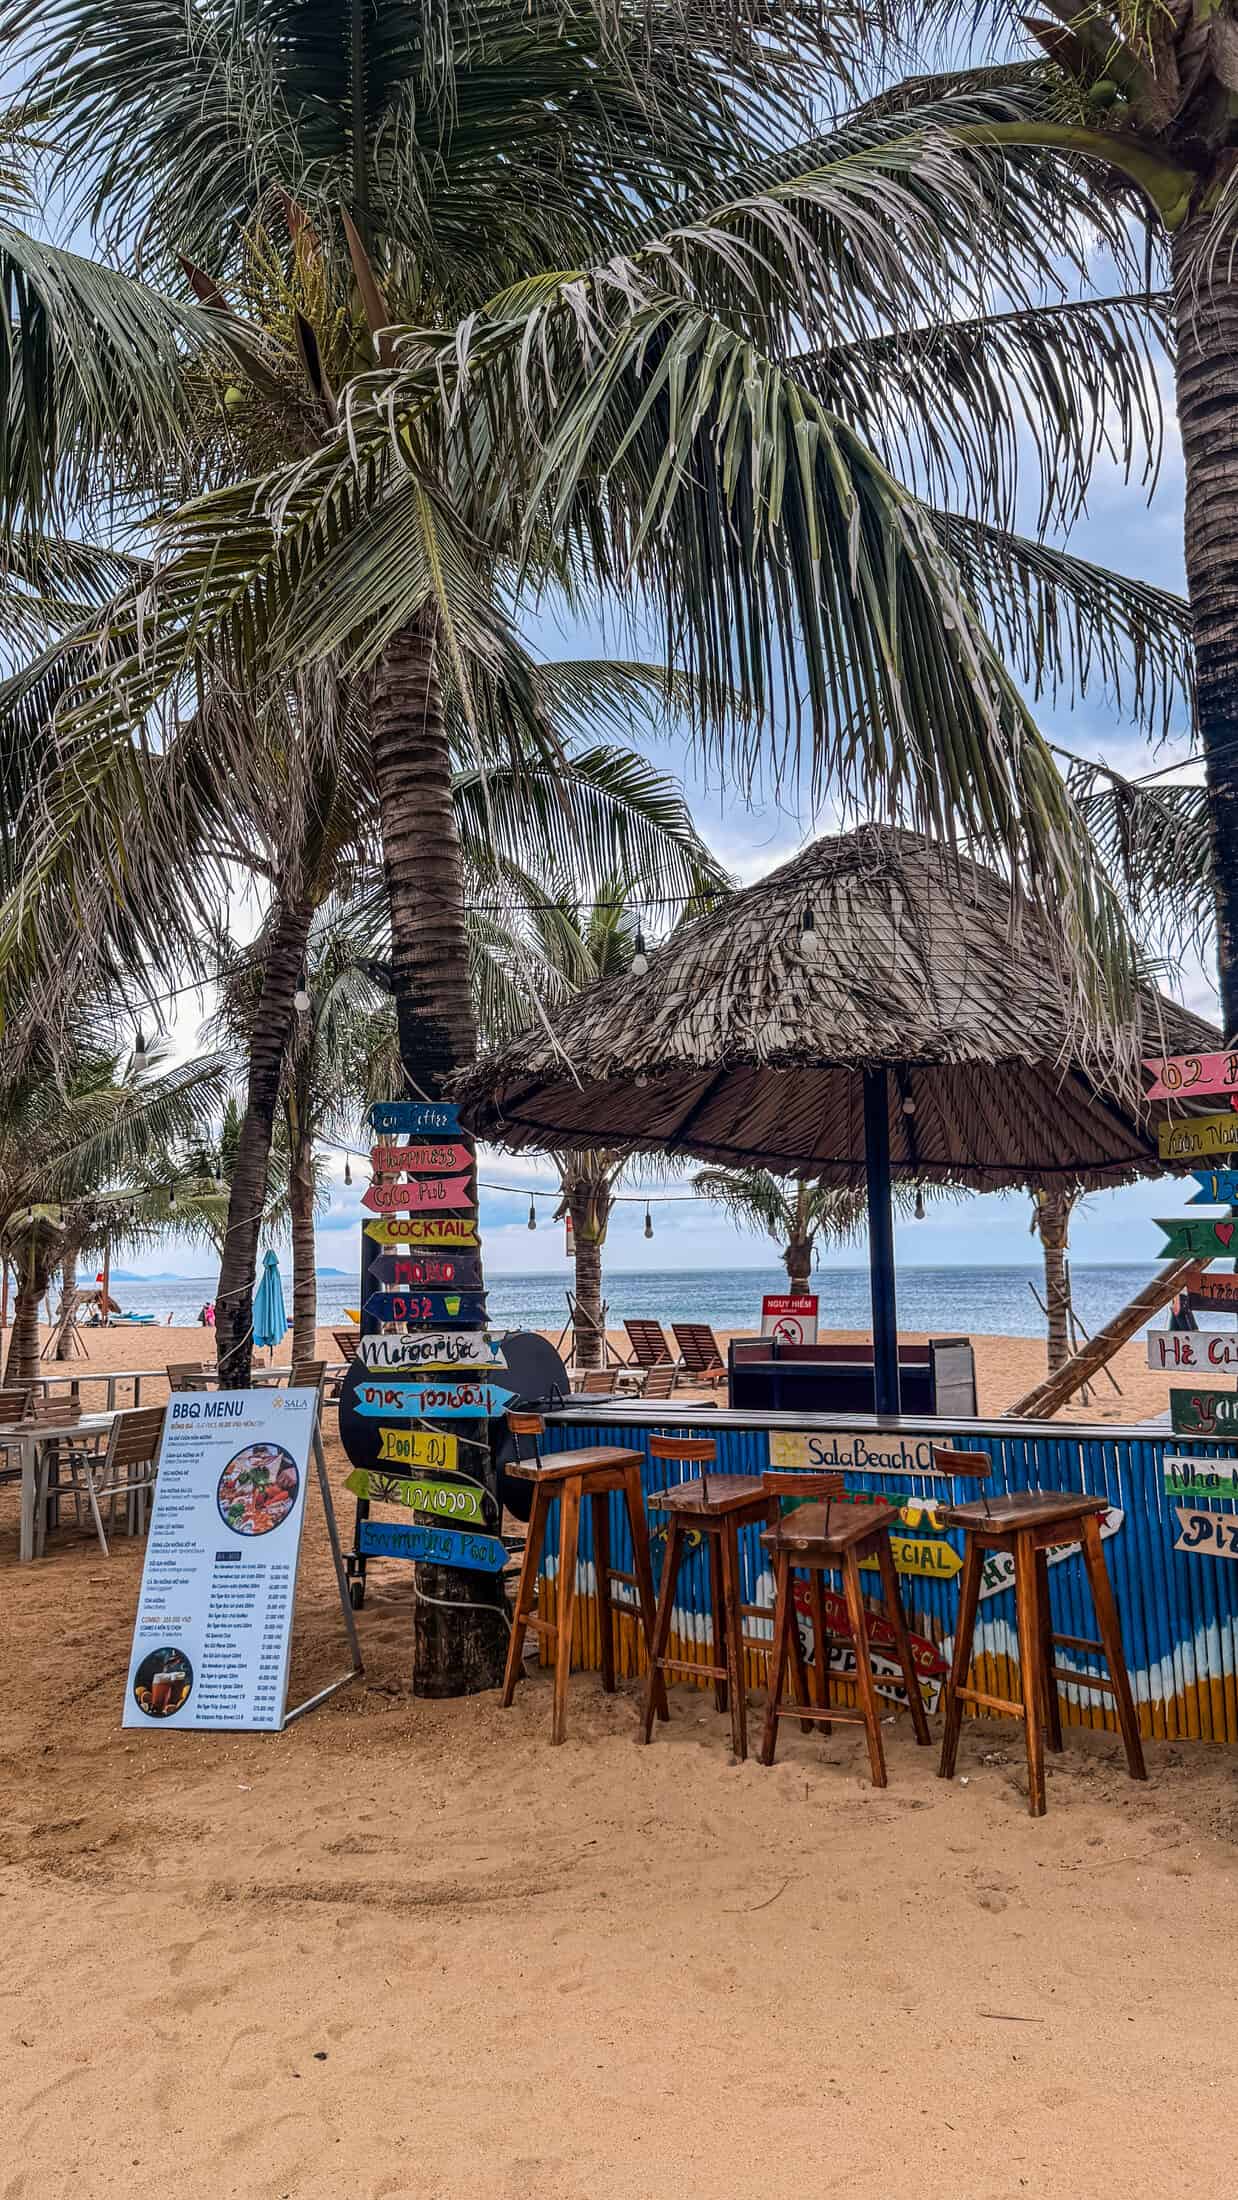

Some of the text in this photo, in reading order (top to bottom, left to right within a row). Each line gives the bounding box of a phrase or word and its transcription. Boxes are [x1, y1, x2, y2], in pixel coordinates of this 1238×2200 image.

[387, 1220, 472, 1238] COCKTAIL
[1158, 1335, 1197, 1368] Hè
[172, 1400, 244, 1419] BBQ MENU
[284, 1400, 308, 1409] SALA
